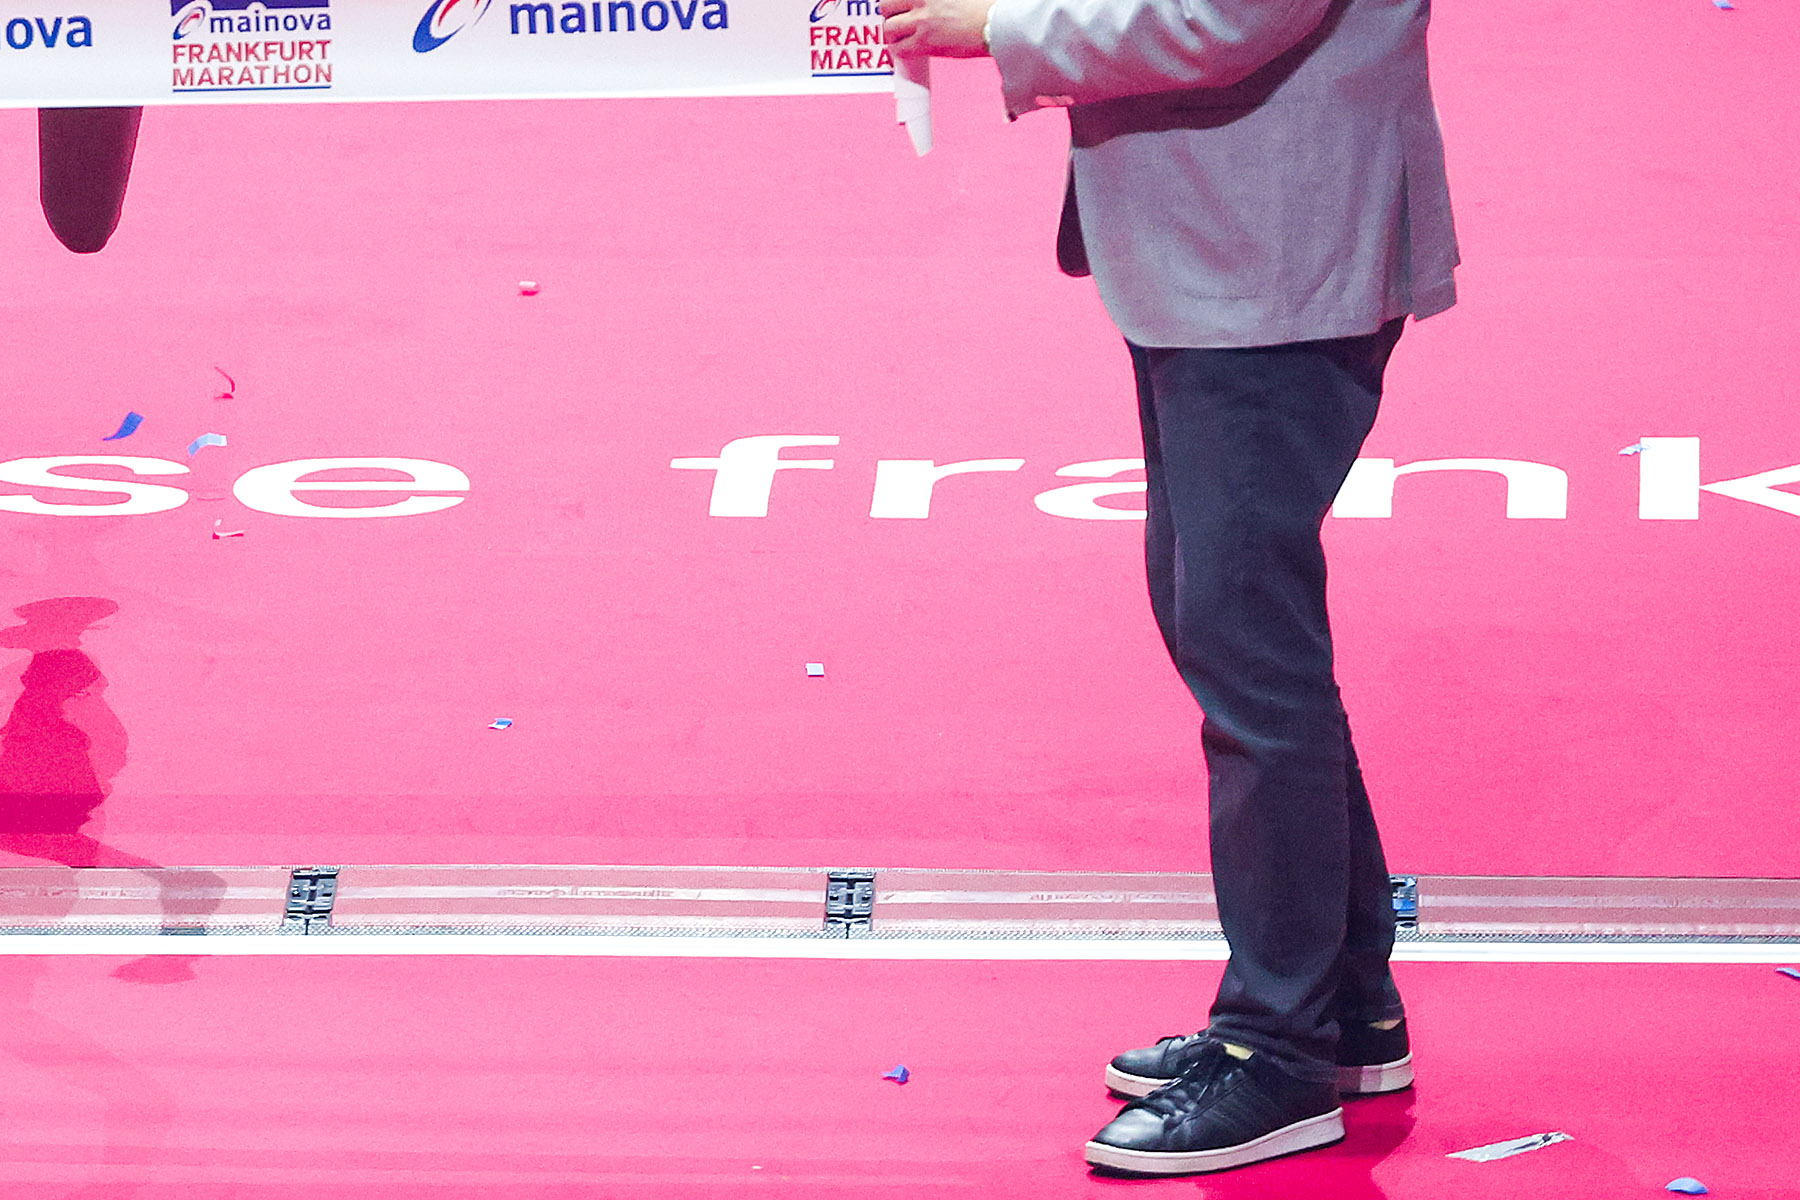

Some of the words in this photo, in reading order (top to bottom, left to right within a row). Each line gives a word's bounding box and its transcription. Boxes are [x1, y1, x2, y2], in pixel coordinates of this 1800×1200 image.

[209, 6, 331, 33] mainova
[172, 40, 332, 63] FRANKFURT
[172, 64, 332, 87] MARATHON
